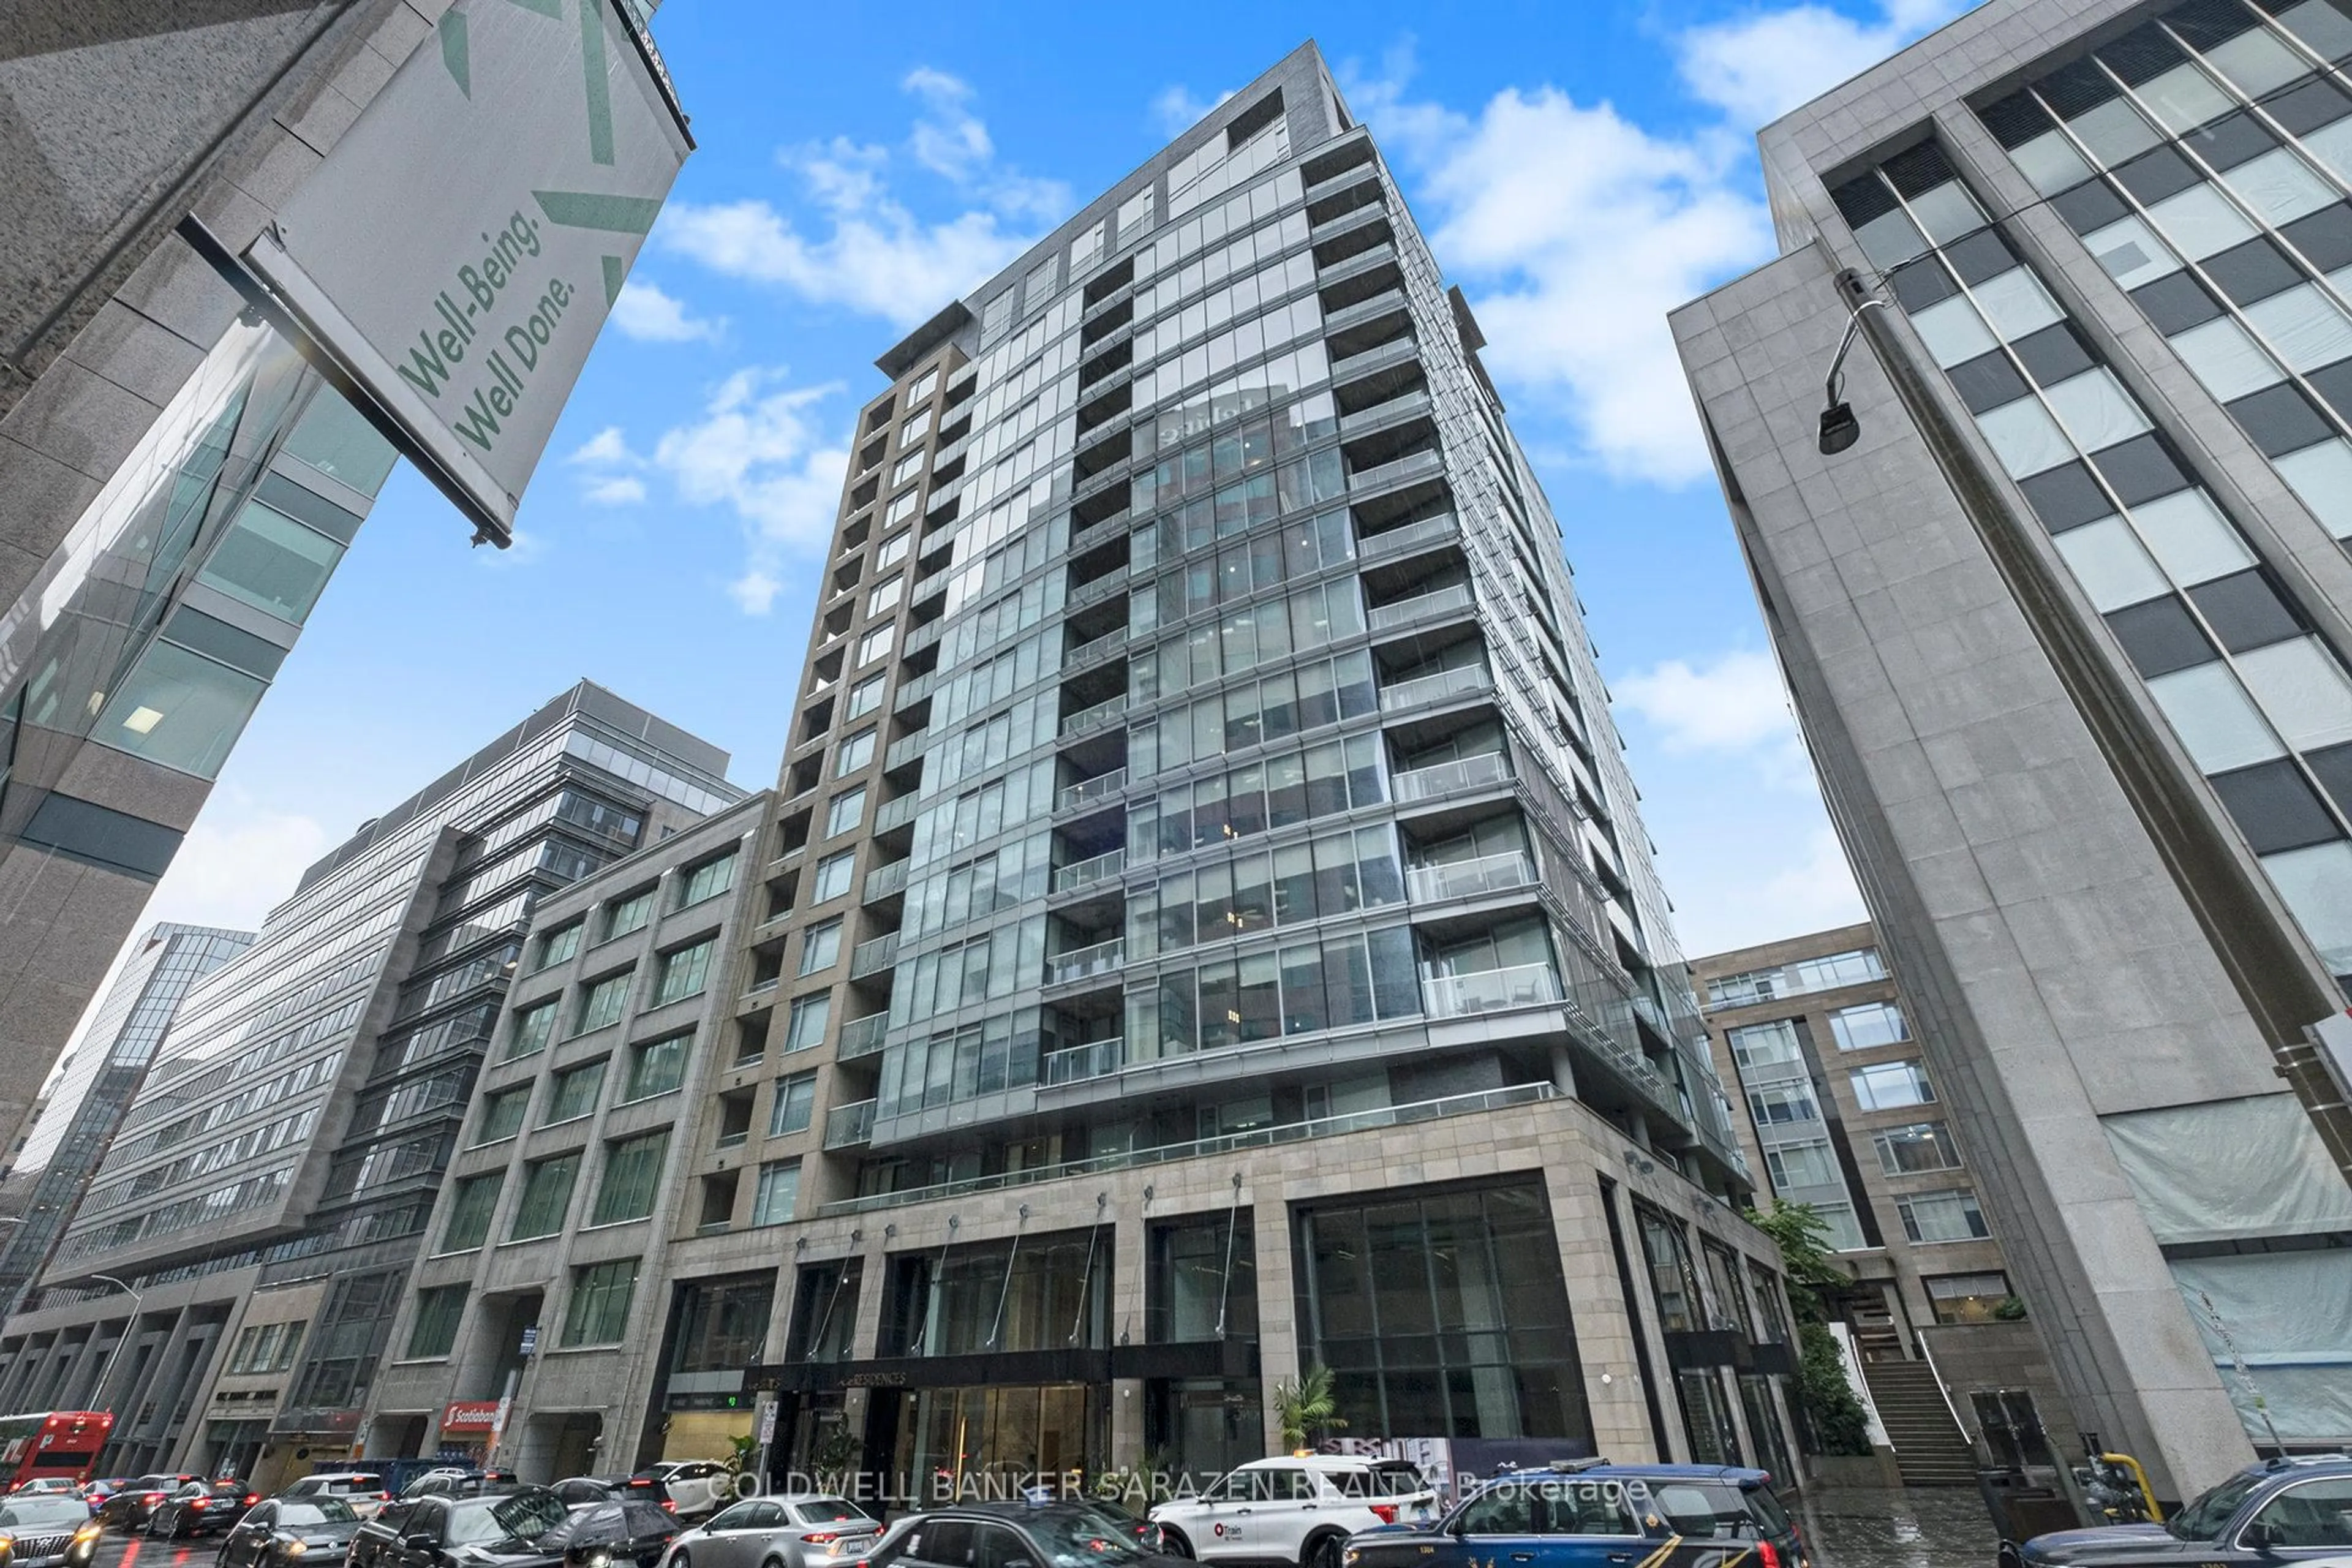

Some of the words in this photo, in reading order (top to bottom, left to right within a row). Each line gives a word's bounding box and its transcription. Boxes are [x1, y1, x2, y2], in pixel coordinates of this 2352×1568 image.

[398, 209, 539, 398] Well-Being.
[454, 349, 524, 452] Well
[505, 277, 575, 372] Done.
[456, 1408, 495, 1423] Scotiaban
